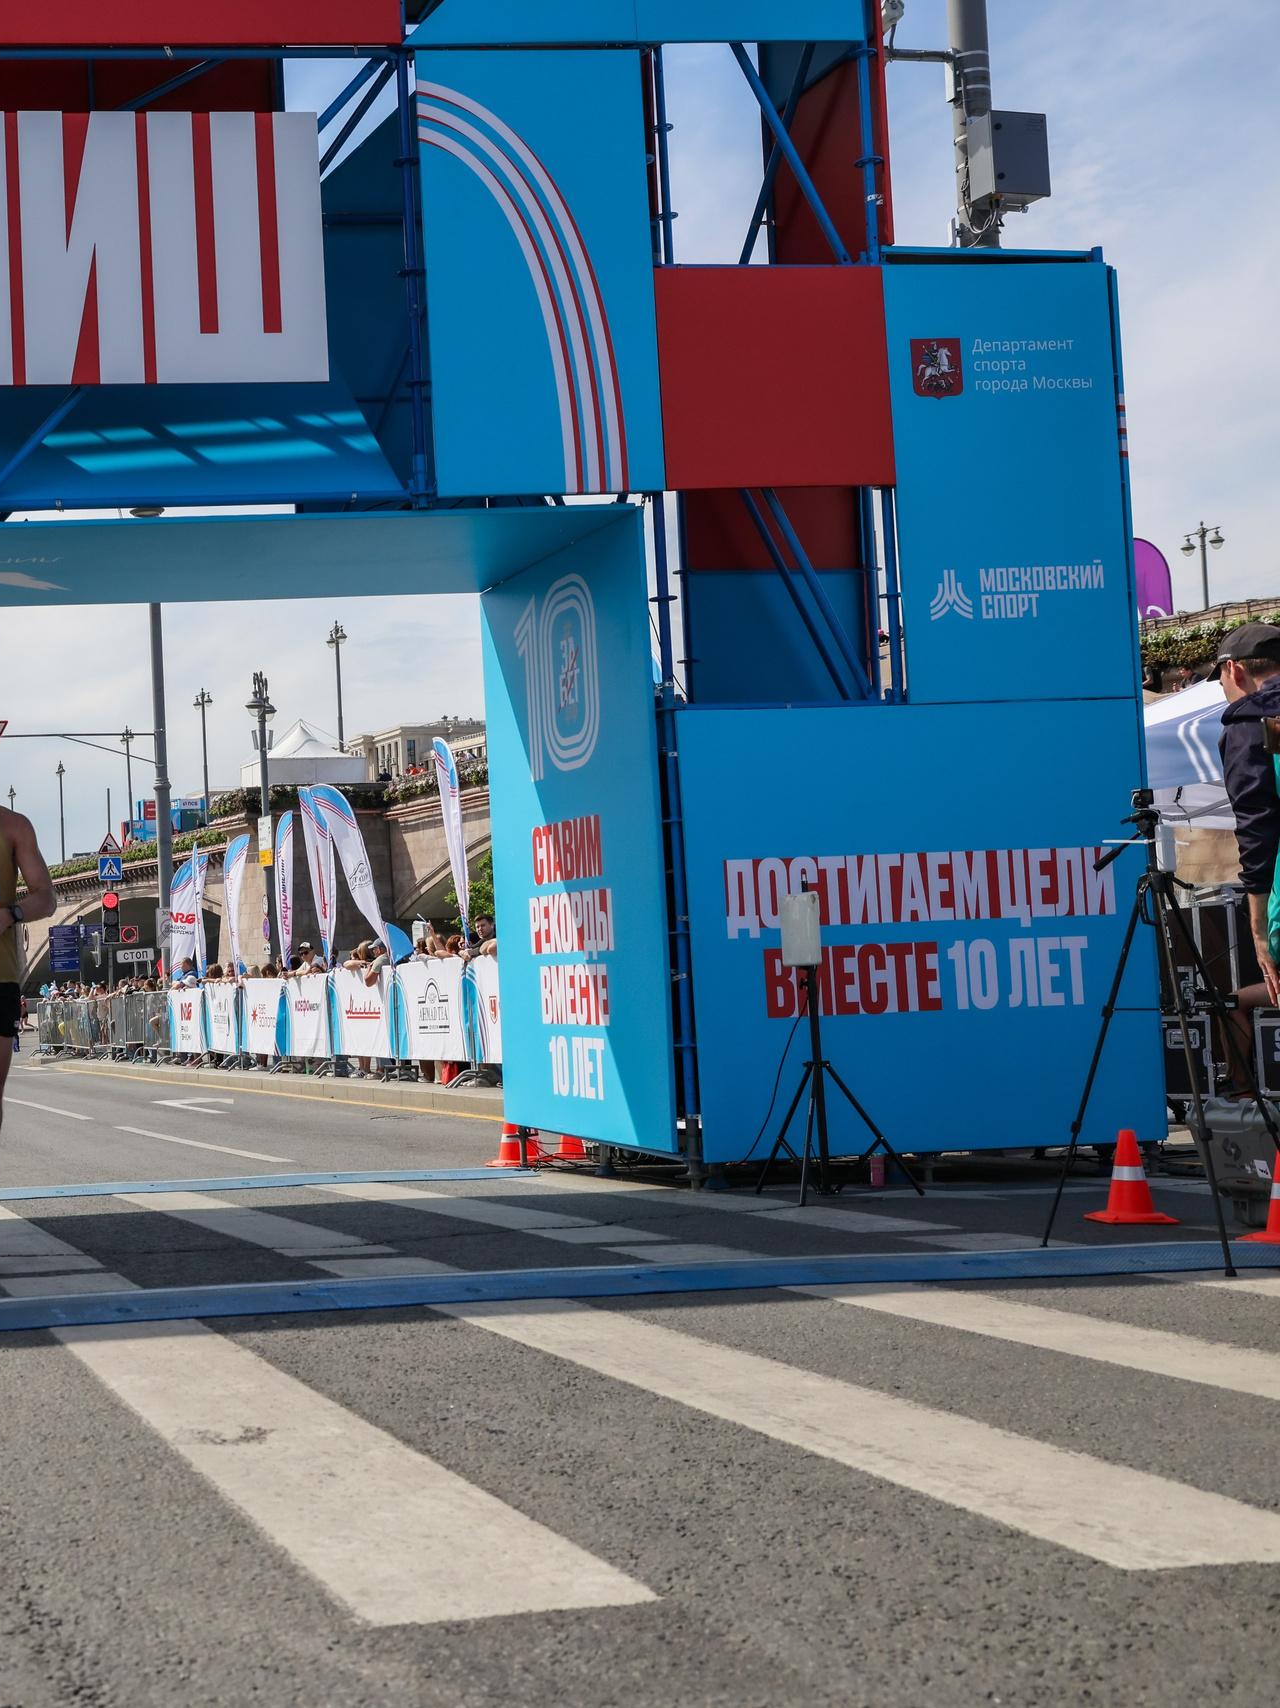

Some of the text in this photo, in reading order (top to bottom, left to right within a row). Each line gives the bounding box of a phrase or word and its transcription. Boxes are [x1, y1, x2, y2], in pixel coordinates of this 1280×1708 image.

[972, 338, 1074, 355] Департамент
[973, 360, 1026, 375] спорта
[975, 376, 1093, 394] города Москвы
[980, 560, 1105, 593] МОСКОВСКИЙ
[981, 593, 1039, 620] СПОРТ
[531, 814, 603, 886] СТАВИМ
[996, 846, 1117, 927] ЦЕЛИ
[529, 888, 615, 960] РЕКОРДЫ
[123, 950, 148, 960] СТОП
[763, 935, 1088, 1018] ВМЕСТЕ 10 ЛЕТ
[540, 963, 610, 1026] ВМЕСТЕ
[549, 1035, 605, 1101] 10 ЛЕТ
